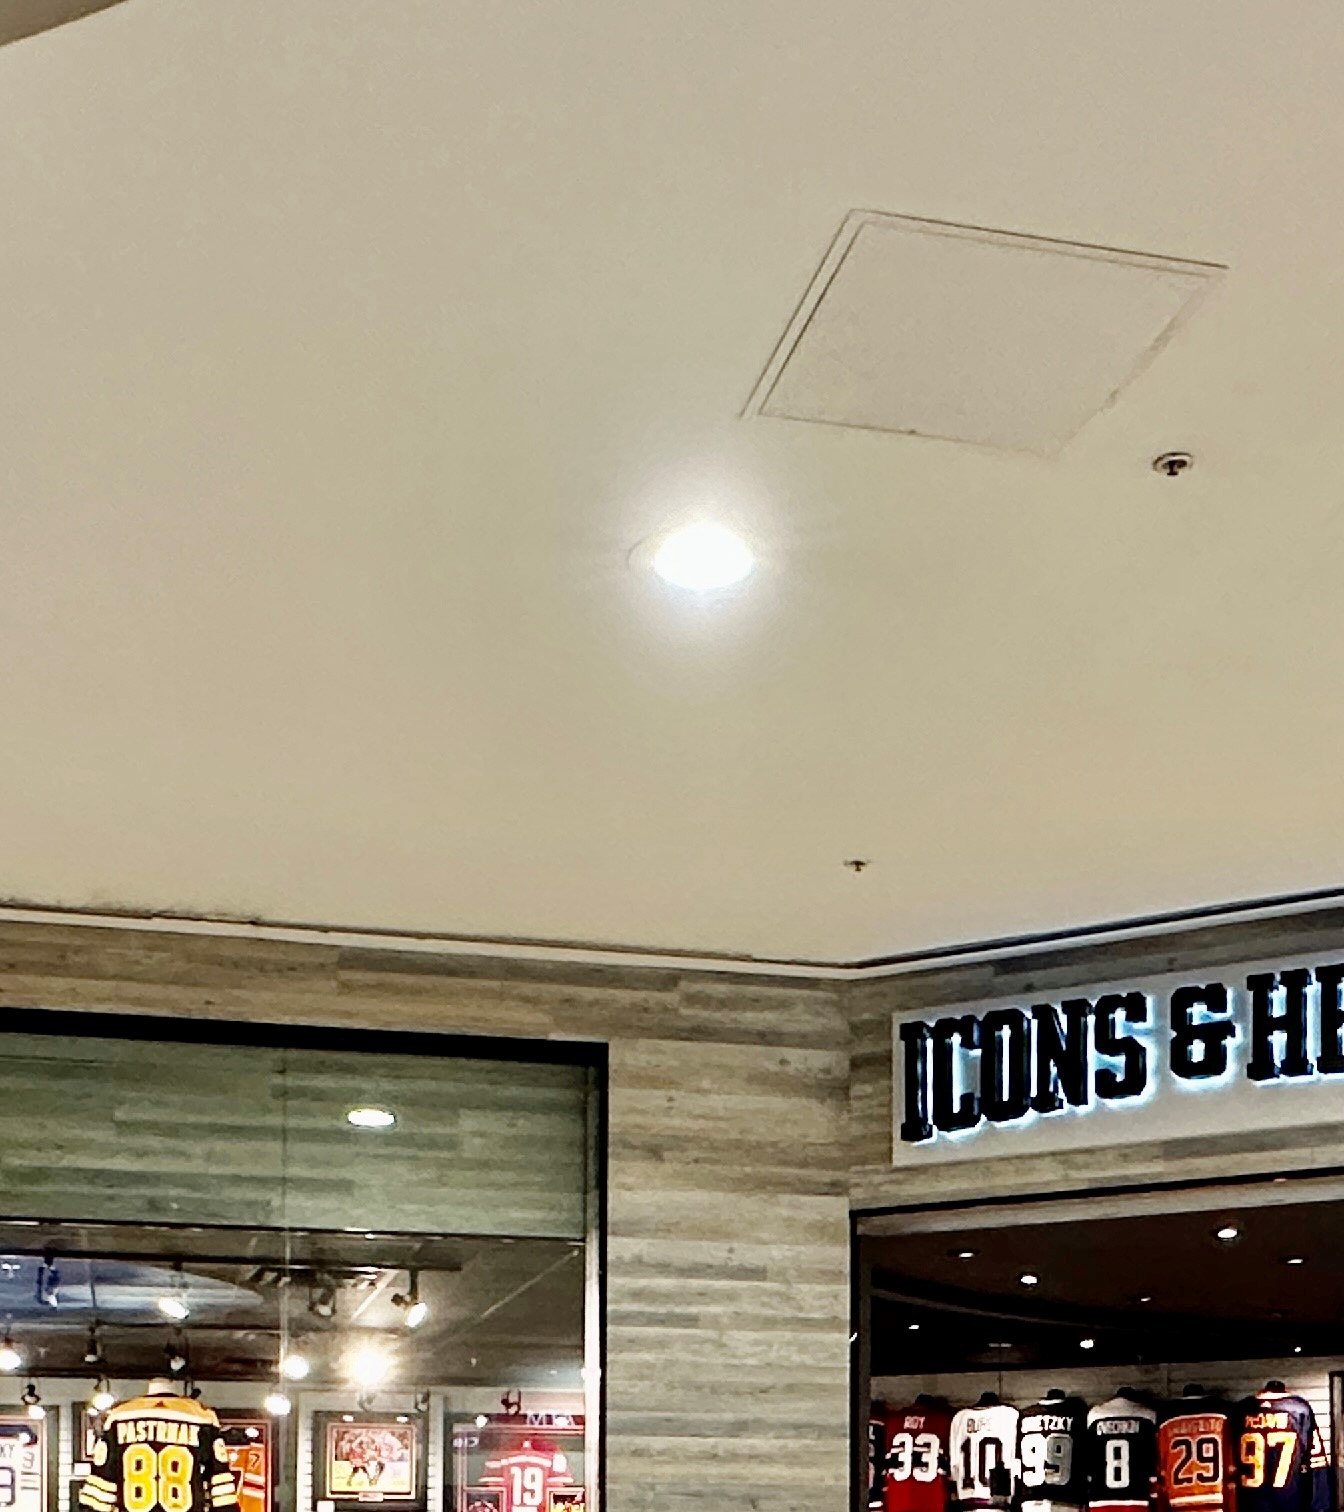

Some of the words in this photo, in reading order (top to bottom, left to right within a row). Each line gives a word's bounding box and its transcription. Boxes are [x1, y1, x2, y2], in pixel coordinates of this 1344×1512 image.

[900, 991, 1147, 1142] ICONS
[1170, 983, 1237, 1079] &
[117, 1421, 200, 1447] PASTRNAK
[892, 1432, 941, 1482] 33
[1020, 1432, 1074, 1487] 99
[1241, 1431, 1297, 1489] 97
[510, 1466, 544, 1506] 19
[1105, 1439, 1130, 1489] 8
[1170, 1433, 1224, 1488] 29
